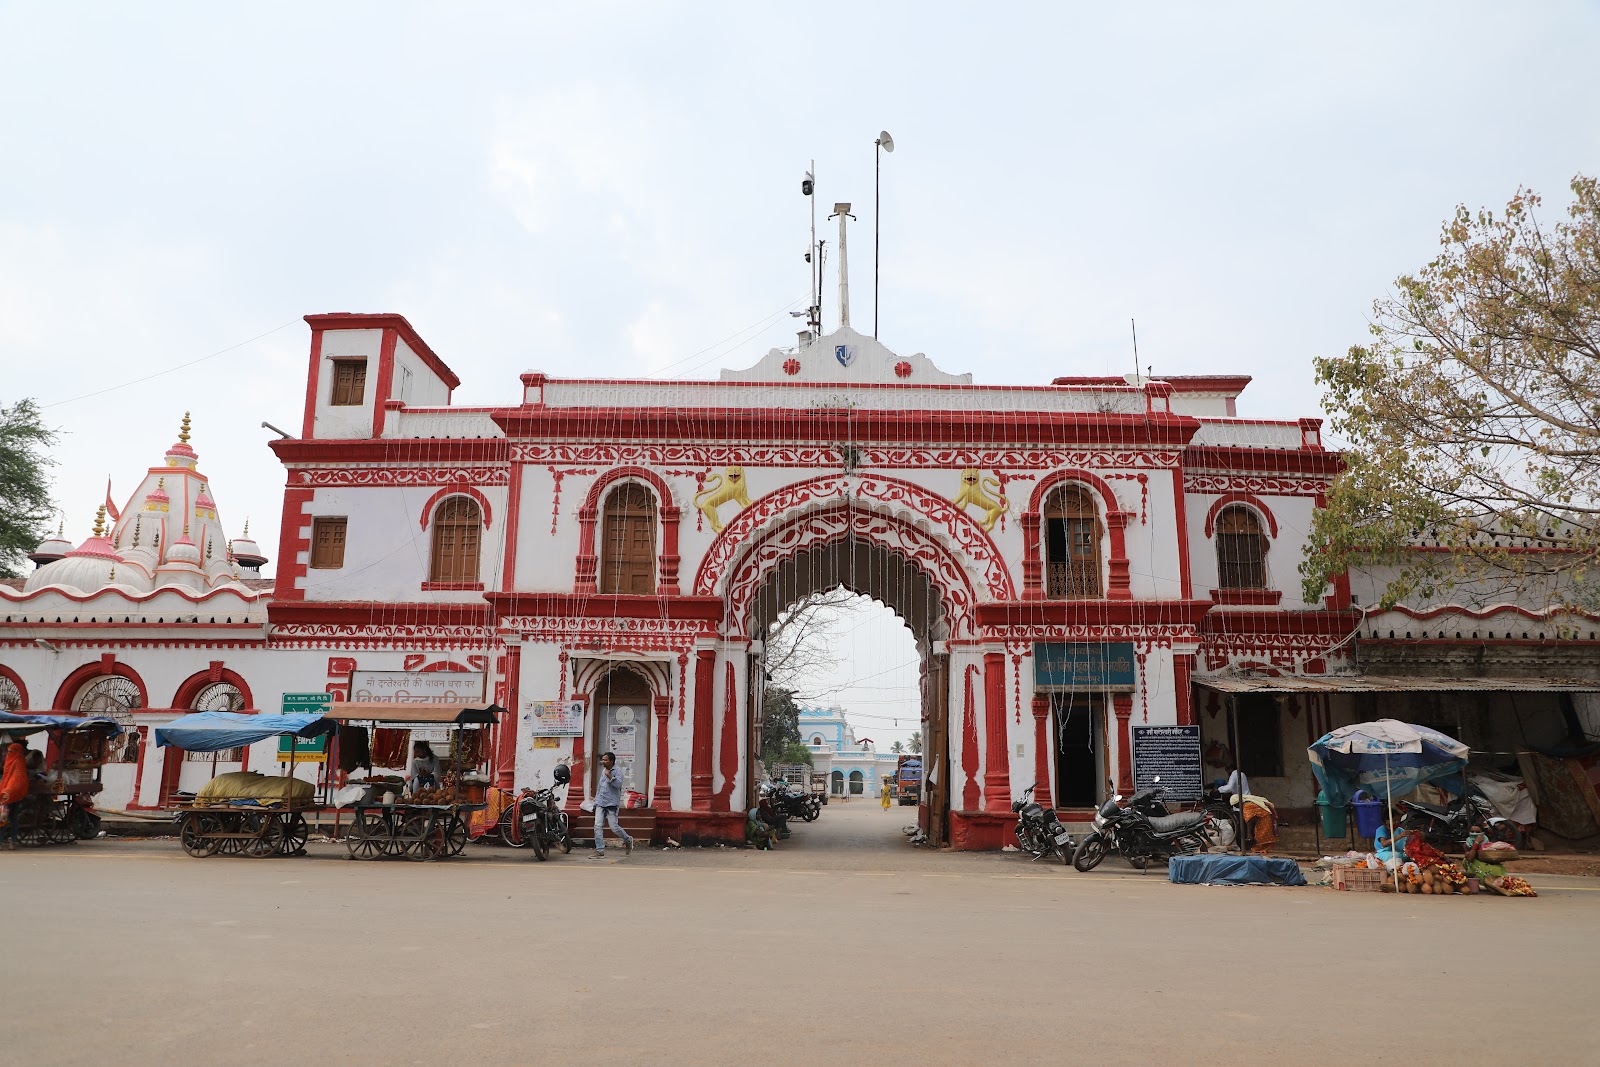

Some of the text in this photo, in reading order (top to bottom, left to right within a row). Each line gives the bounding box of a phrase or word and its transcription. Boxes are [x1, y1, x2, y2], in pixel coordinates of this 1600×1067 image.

[377, 676, 410, 688] दन्तेश्वरी
[412, 677, 422, 688] की
[425, 679, 445, 688] पावन
[447, 679, 462, 688] धरा
[464, 679, 475, 688] पर
